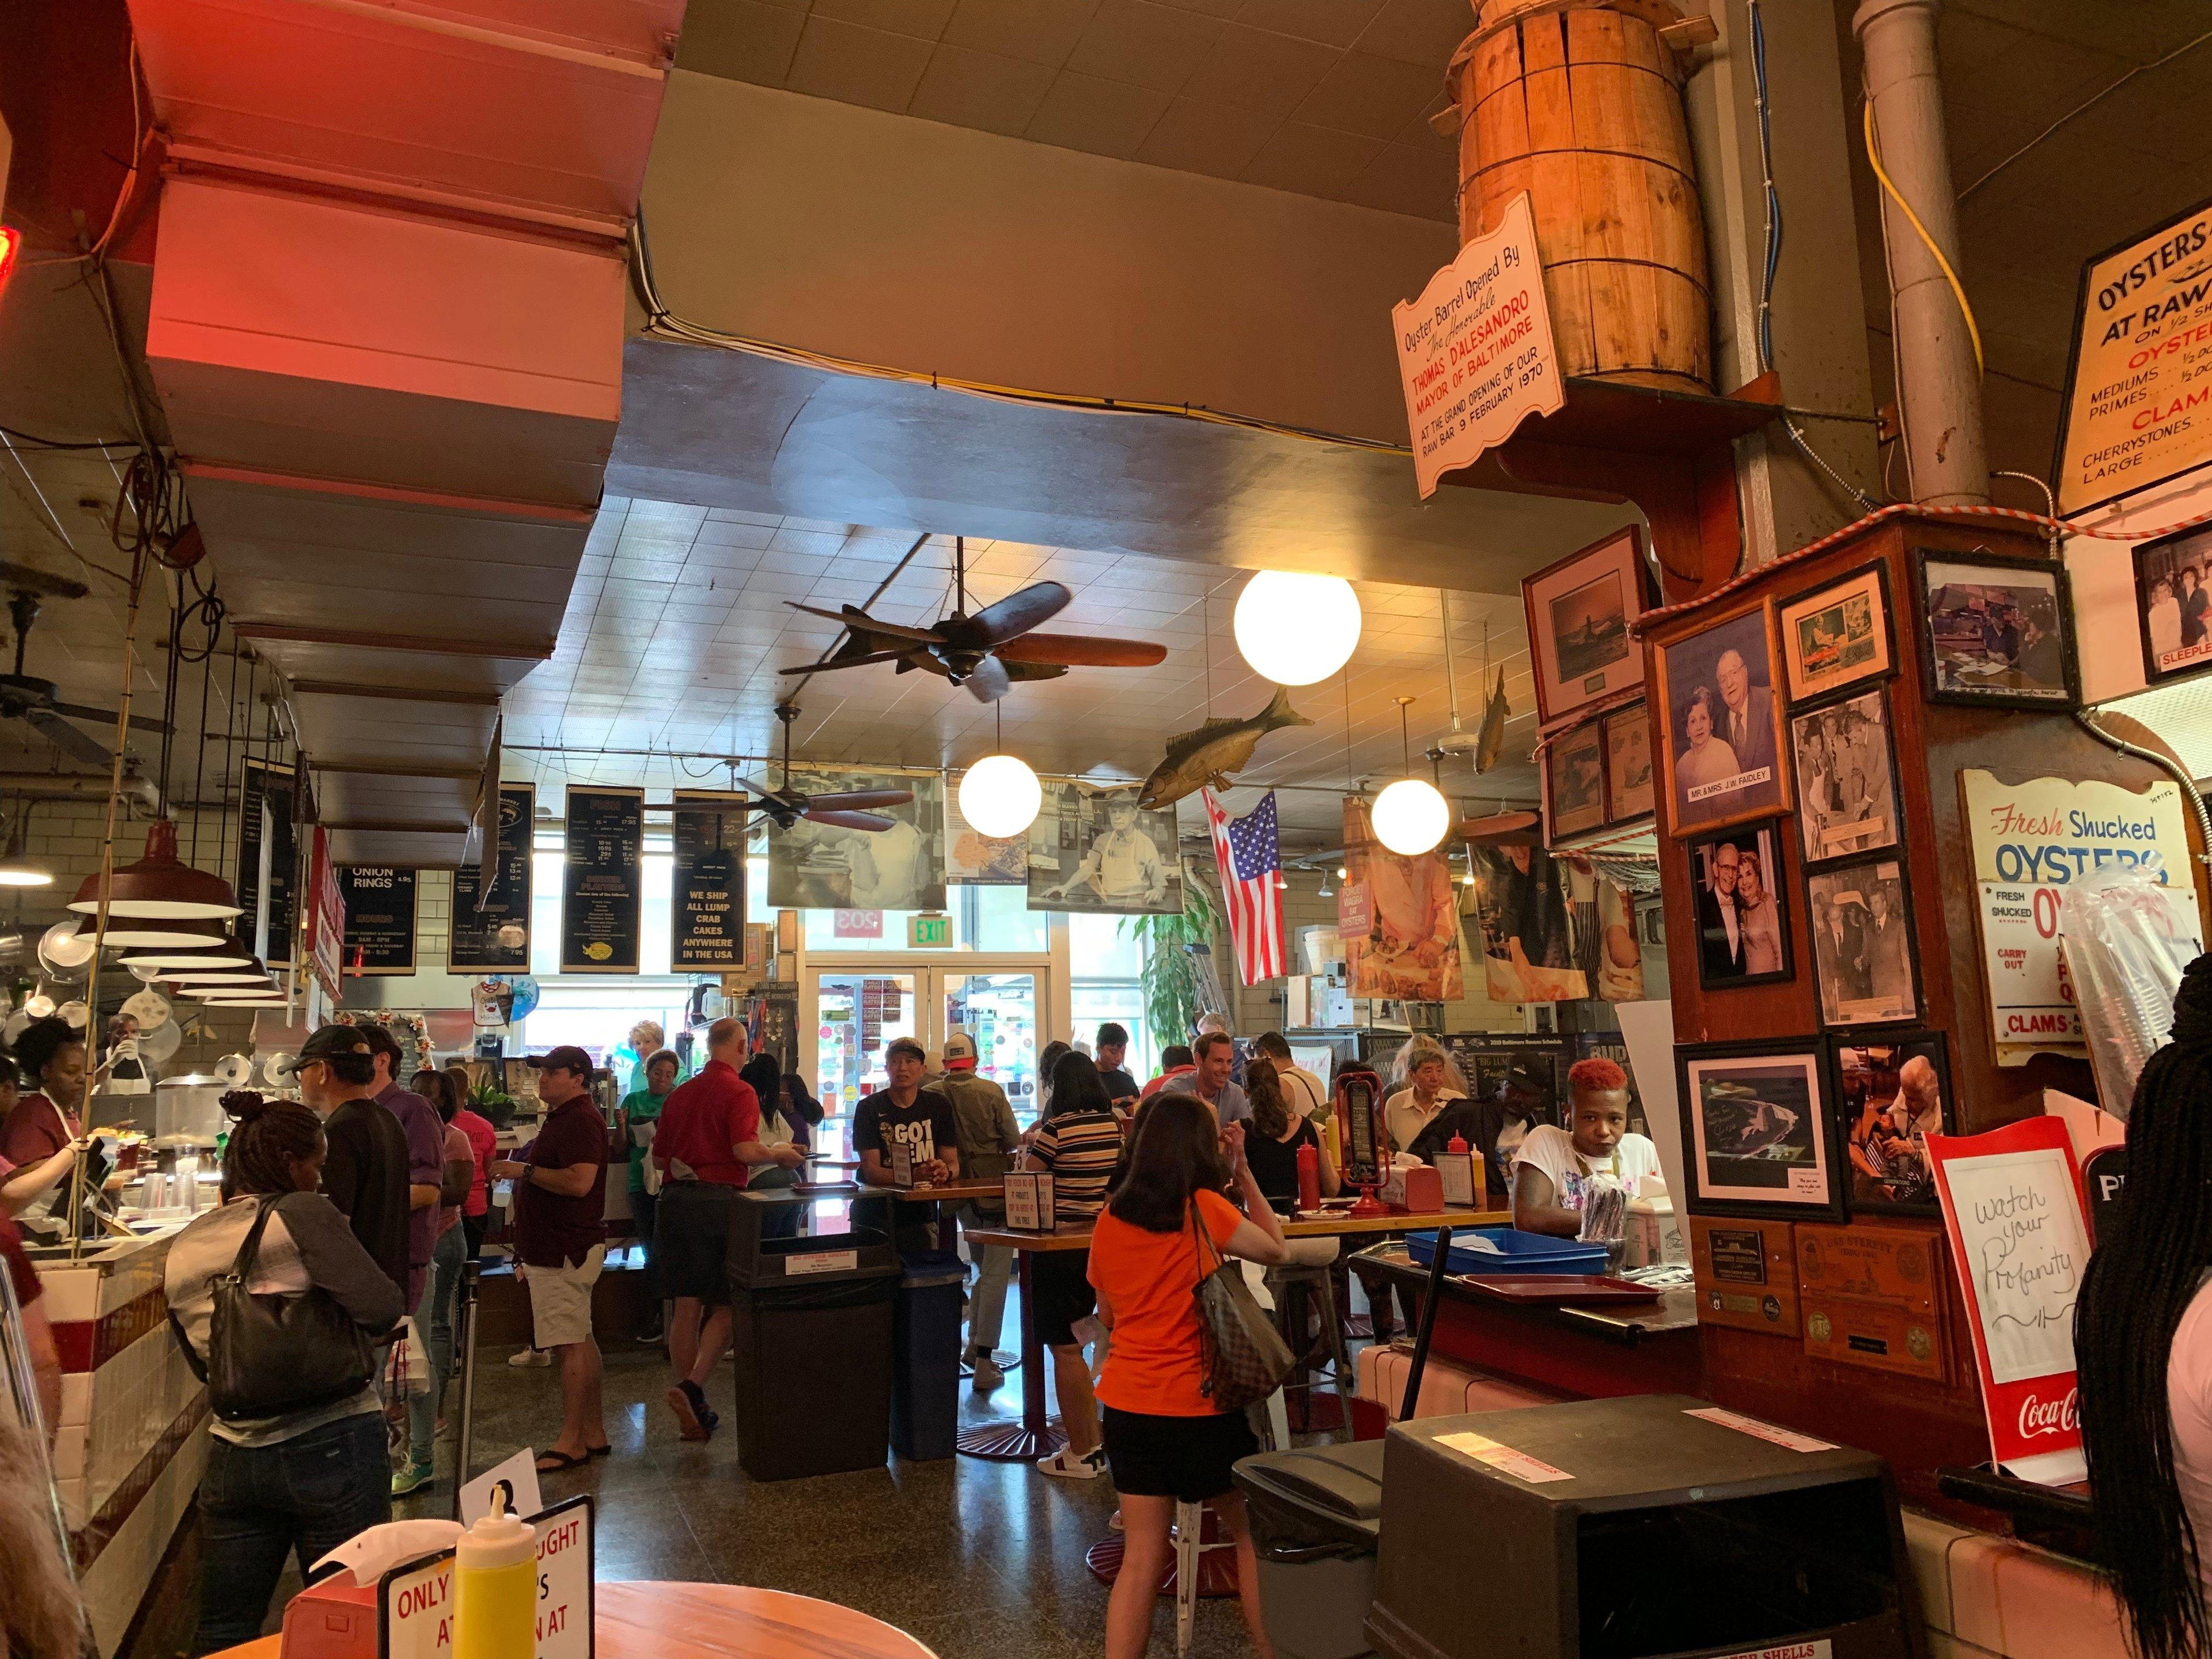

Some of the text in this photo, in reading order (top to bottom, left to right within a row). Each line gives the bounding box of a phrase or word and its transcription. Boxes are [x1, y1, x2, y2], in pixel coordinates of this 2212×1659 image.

[2098, 221, 2209, 311] OYSTERS
[1405, 244, 1520, 353] Oyster Barrel Opened By
[2101, 278, 2212, 346] AT RAW
[1426, 287, 1496, 362] The Honorable
[2135, 325, 2161, 344] ON
[1412, 289, 1529, 397] THOMAS D'ALESANDRO
[1416, 316, 1533, 417] MAYOR OF BALTIMORE
[1421, 346, 1539, 441] AT THE GRAND OPENING OF OUR
[2090, 366, 2159, 404] MEDIUMS
[1422, 362, 1544, 459] RAW BAR 9 FEBRUARY 1970
[2089, 387, 2147, 421] PRIMES
[2132, 385, 2212, 431] CLAM
[2082, 416, 2193, 469] CHERRYSTONES
[2083, 452, 2143, 484] LARGE
[1708, 783, 1722, 794] MRS.
[1725, 780, 1737, 789] J.W.
[1738, 770, 1766, 785] FAIDLEY
[1990, 802, 2156, 840] Fresh Shucked
[353, 868, 393, 876] ONION
[354, 878, 392, 888] RINGS
[690, 891, 728, 900] WE SHIP
[1343, 884, 1363, 897] FORGET
[1344, 895, 1363, 907] VIAGRA
[1996, 891, 2025, 902] FRESH
[687, 903, 730, 911] ALL LUMP
[1349, 907, 1357, 915] EAT
[1992, 907, 2032, 918] SHUCKED
[693, 927, 723, 935] CAKES
[916, 921, 946, 942] EXIT
[1342, 914, 1366, 928] OYSTERS
[683, 938, 733, 947] ANYWHERE
[683, 950, 733, 959] IN THE USA
[1997, 948, 2027, 959] CARRY
[2005, 960, 2023, 969] OUT
[2008, 1014, 2067, 1033] CLAMS
[895, 1119, 932, 1143] GOT
[1017, 1150, 1022, 1170] 5
[2002, 1214, 2049, 1249] your
[1982, 1236, 2075, 1297] Profanity
[2018, 1387, 2081, 1438] Coca-C
[536, 1520, 579, 1560] UGHT
[397, 1573, 449, 1619] ONLY
[547, 1605, 568, 1637] AT
[1763, 1643, 1815, 1659] SHELLS
